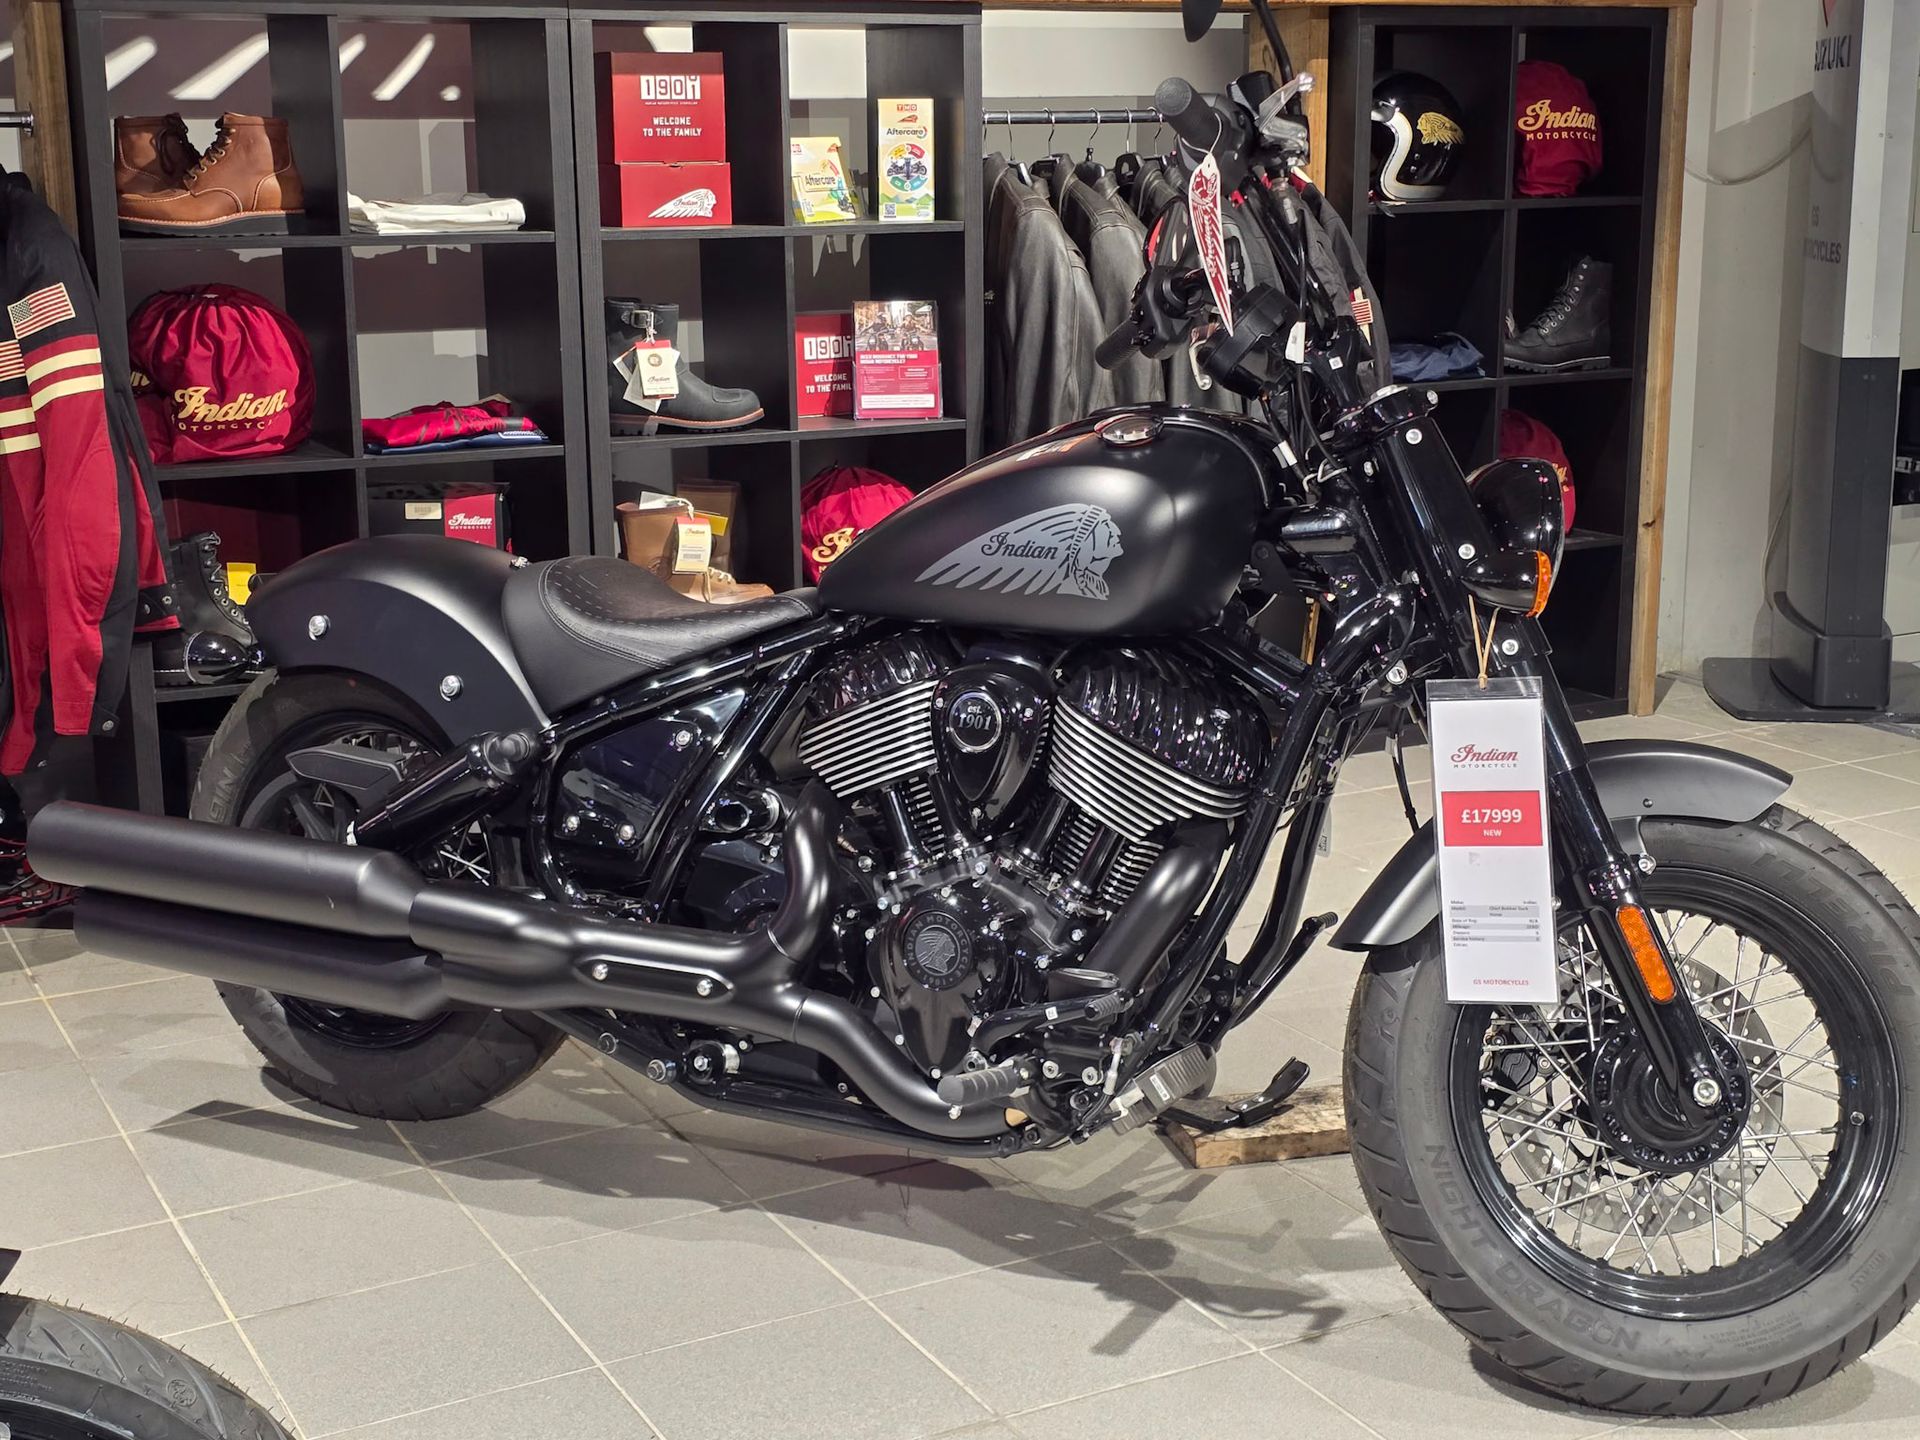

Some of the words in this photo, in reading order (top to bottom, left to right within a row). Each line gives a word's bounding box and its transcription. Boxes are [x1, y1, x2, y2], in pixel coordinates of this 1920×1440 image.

[653, 117, 691, 125] WELCOME
[1518, 99, 1597, 131] Indian
[643, 128, 653, 136] TO
[656, 128, 671, 136] THE
[675, 128, 702, 136] FAMILY
[887, 128, 924, 136] Aftercare
[814, 373, 847, 382] WELCOME
[806, 385, 815, 393] TO
[817, 384, 831, 392] THE
[832, 382, 853, 391] FAMIL
[174, 386, 288, 422] Indian
[448, 513, 492, 526] Indian
[981, 532, 1059, 559] Indian
[959, 713, 992, 730] 1901
[1451, 744, 1519, 762] Indian
[1461, 808, 1522, 823] £17999
[1483, 829, 1502, 837] NEW
[926, 915, 970, 977] MOTORCYCLE
[1425, 1144, 1500, 1253] NIGHT
[1495, 1262, 1643, 1351] DRAGON
